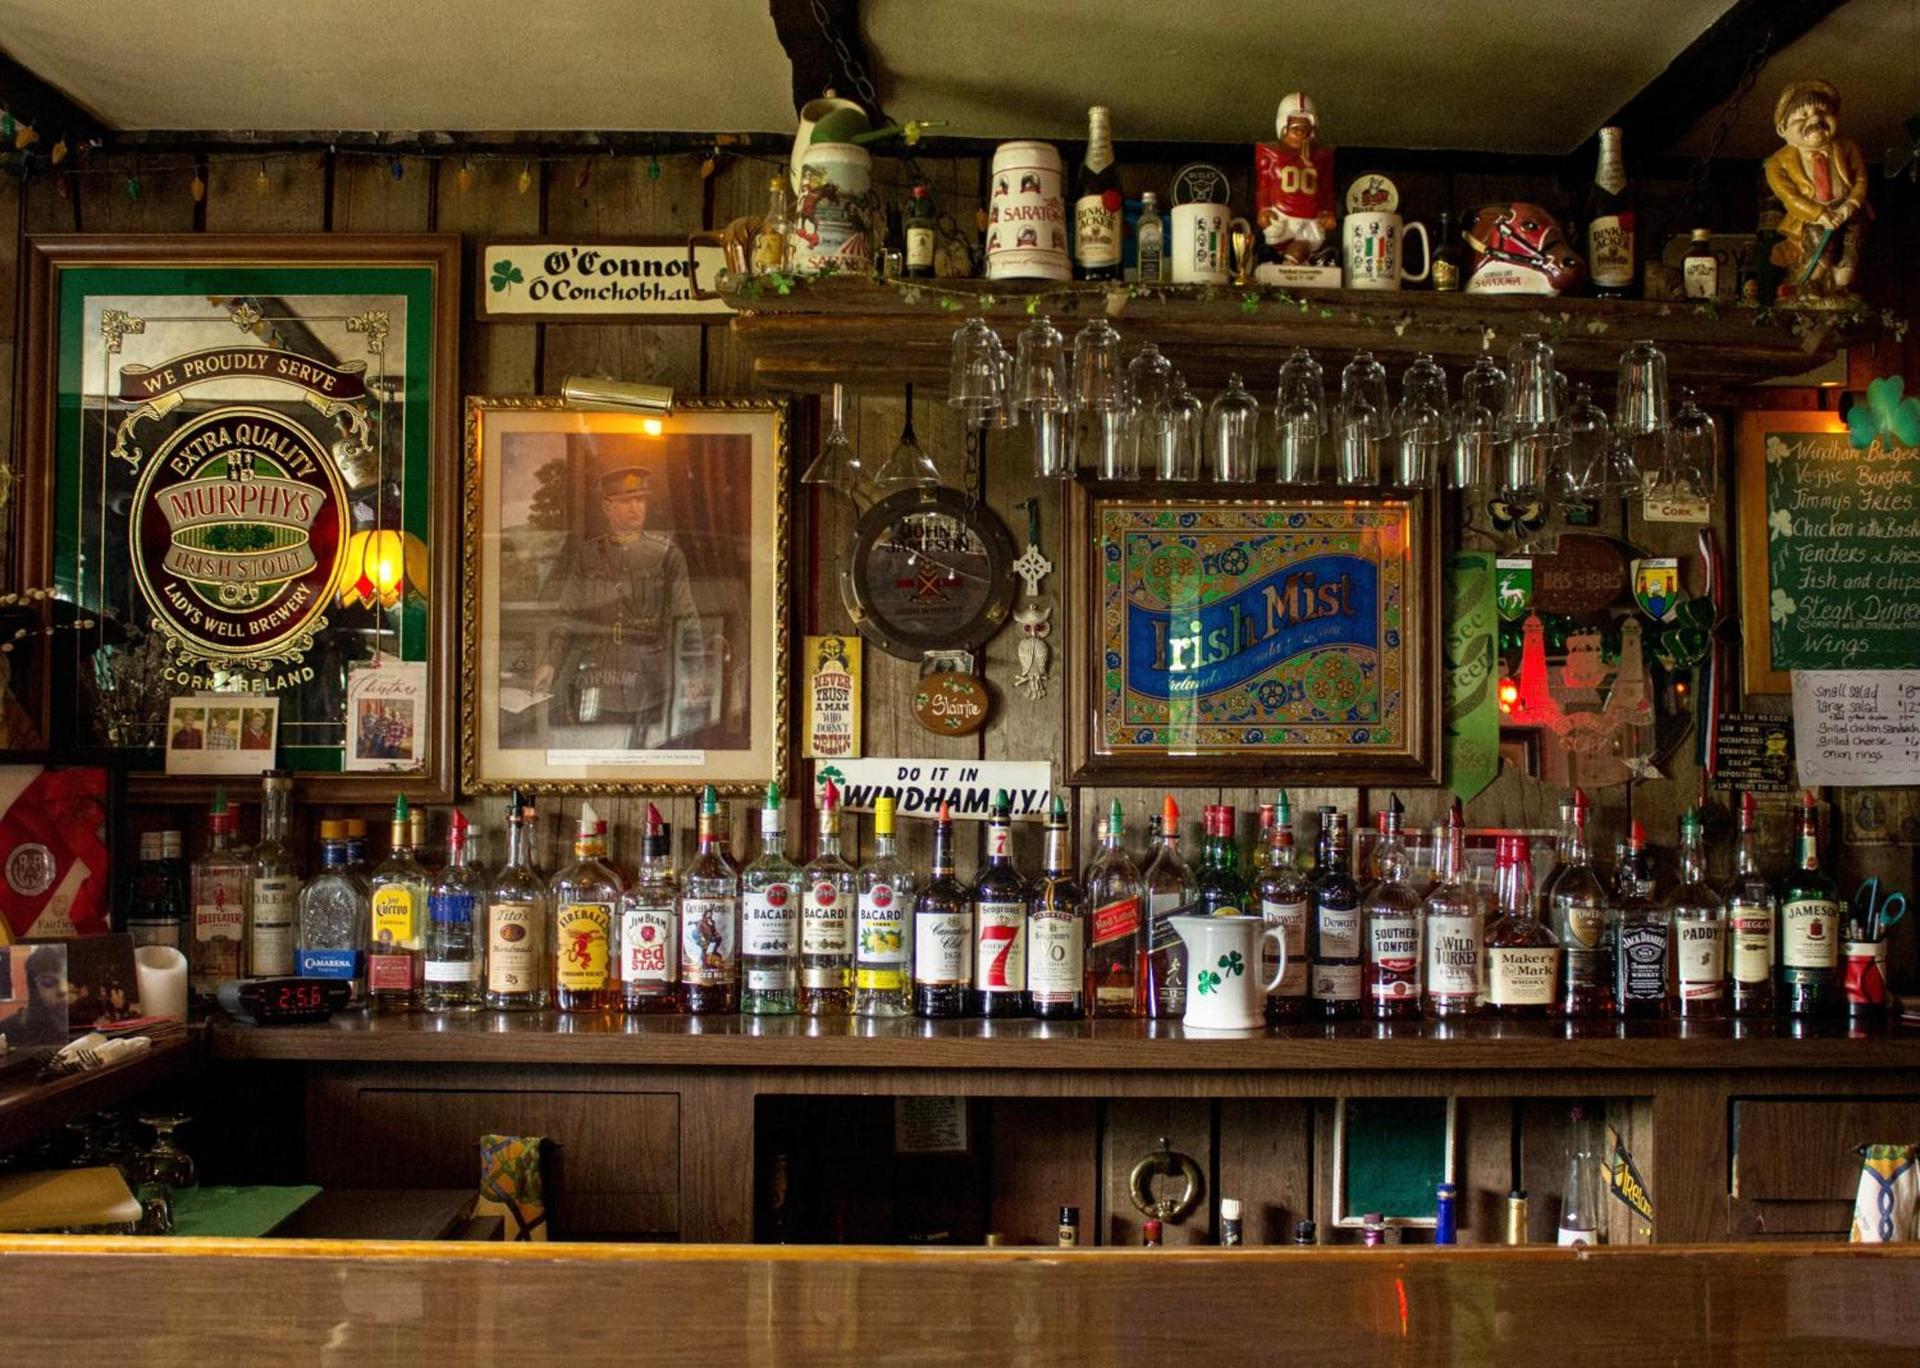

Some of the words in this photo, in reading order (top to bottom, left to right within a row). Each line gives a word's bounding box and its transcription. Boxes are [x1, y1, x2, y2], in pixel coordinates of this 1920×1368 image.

[544, 247, 699, 277] O'Connor
[144, 369, 176, 393] WE
[184, 354, 267, 376] PROUDLY
[277, 360, 338, 391] SERVE
[170, 426, 232, 477] EXTRA
[235, 423, 318, 478] QUALITY
[1790, 440, 1859, 461] Windham
[1795, 462, 1846, 487] Veggie
[1793, 516, 1853, 537] Chicken
[175, 551, 231, 577] IRISH
[237, 551, 303, 577] STOUT
[1798, 566, 1840, 589] Fish
[1843, 572, 1872, 589] and
[164, 582, 203, 625] LADY'S
[204, 616, 246, 637] WELL
[249, 582, 312, 635] BREWERY
[1800, 595, 1857, 620] Steak
[1151, 603, 1259, 672] Irish
[1261, 570, 1356, 640] Mist
[1801, 633, 1870, 666] Wings
[231, 667, 315, 692] RELAND
[814, 672, 851, 689] NEVER
[816, 687, 849, 701] TRUST
[1812, 683, 1846, 698] small
[1848, 683, 1879, 699] salad
[816, 703, 823, 711] A
[825, 703, 849, 711] MAN
[1817, 700, 1845, 714] large
[1848, 700, 1878, 713] salad
[1817, 722, 1848, 733] grilled
[813, 734, 851, 755] DRINK
[1816, 735, 1849, 747] grilled
[1822, 749, 1851, 760] onion
[1855, 750, 1883, 763] rings
[897, 766, 921, 781] DO
[931, 767, 950, 782] IT
[959, 768, 979, 782] IN
[844, 784, 991, 815] WINDHAM
[995, 833, 1007, 855] 7
[496, 910, 529, 921] Tito's
[629, 916, 644, 929] JIM
[645, 912, 667, 929] BEAM
[1623, 934, 1639, 949] JACK
[1683, 927, 1719, 940] PADDY
[632, 943, 665, 960] red
[1443, 936, 1474, 951] WILD
[631, 960, 665, 971] STAG
[981, 925, 1020, 987] 7
[1435, 947, 1479, 966] TURKEY
[1502, 953, 1555, 964] Maker's
[1517, 966, 1553, 976] Mark
[279, 986, 321, 1009] 2:56
